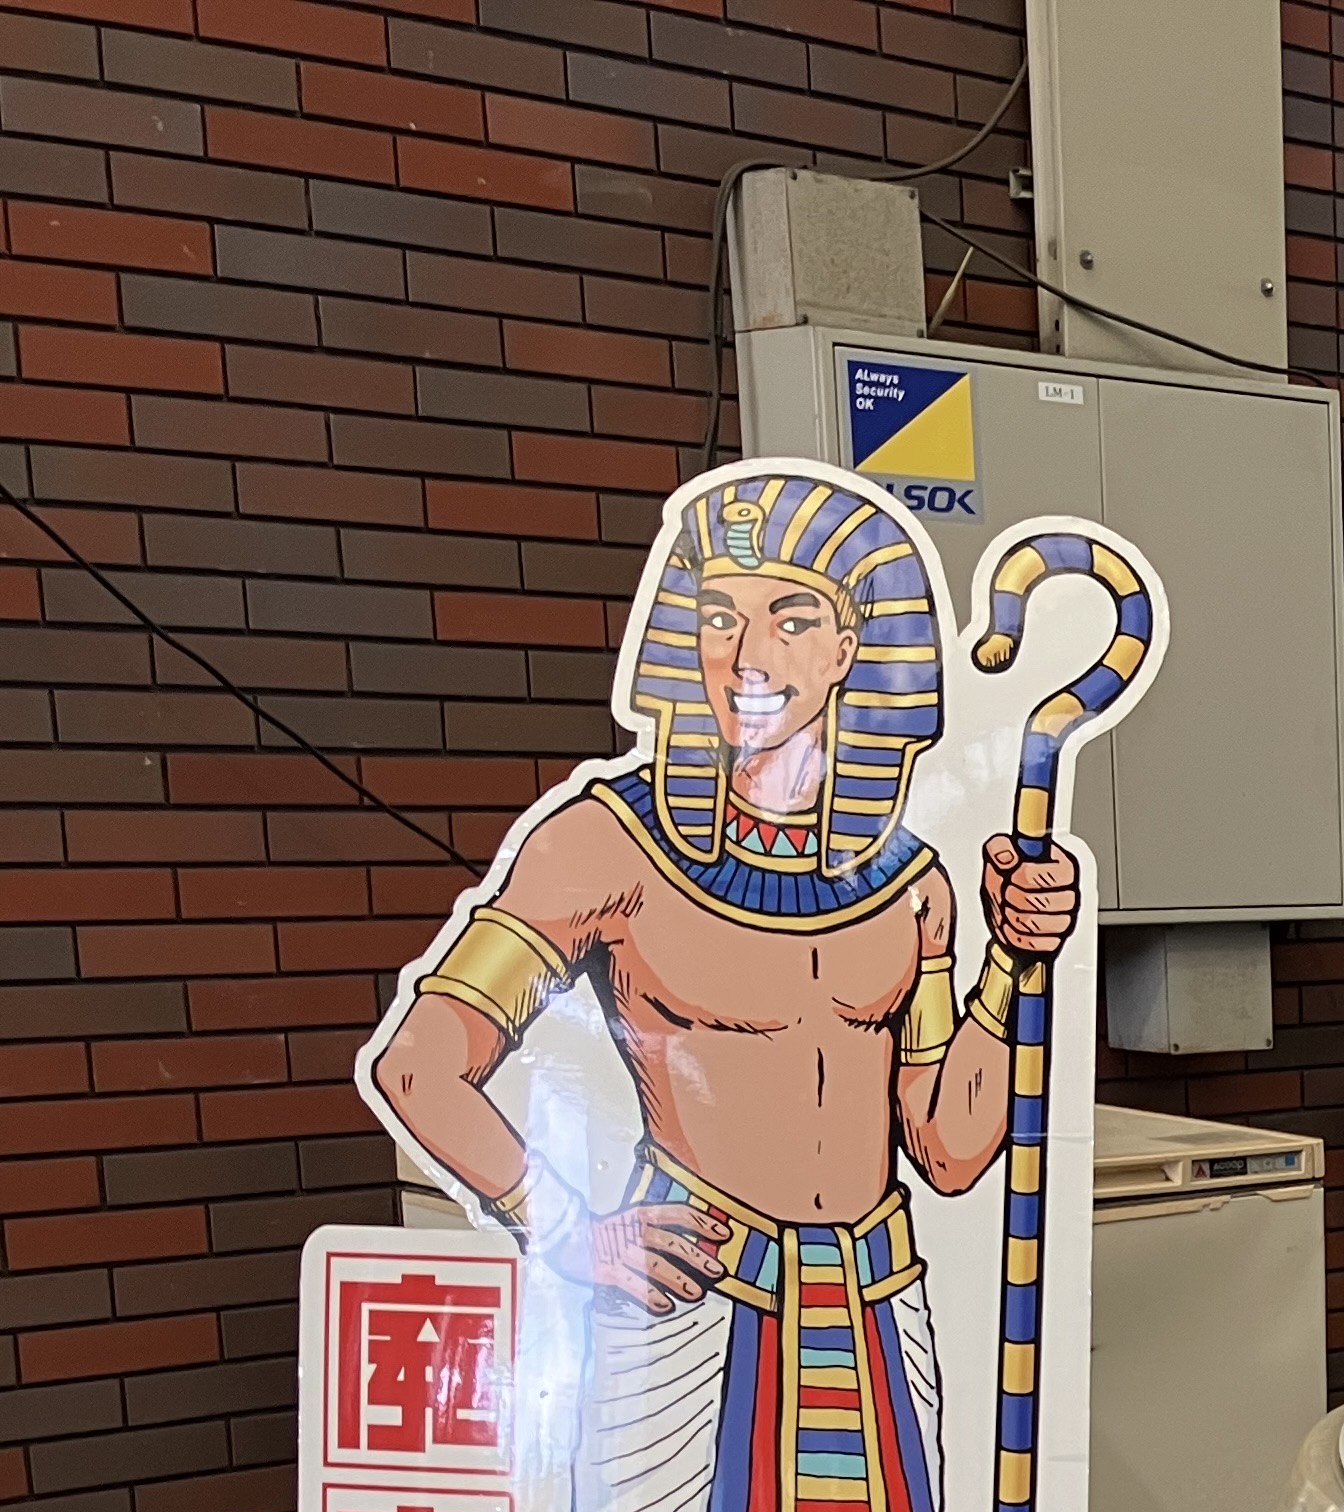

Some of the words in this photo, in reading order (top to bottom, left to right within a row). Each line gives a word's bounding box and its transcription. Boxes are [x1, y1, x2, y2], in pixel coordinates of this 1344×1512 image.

[855, 382, 906, 402] Security
[855, 397, 875, 411] OK
[886, 483, 976, 515] SOK
